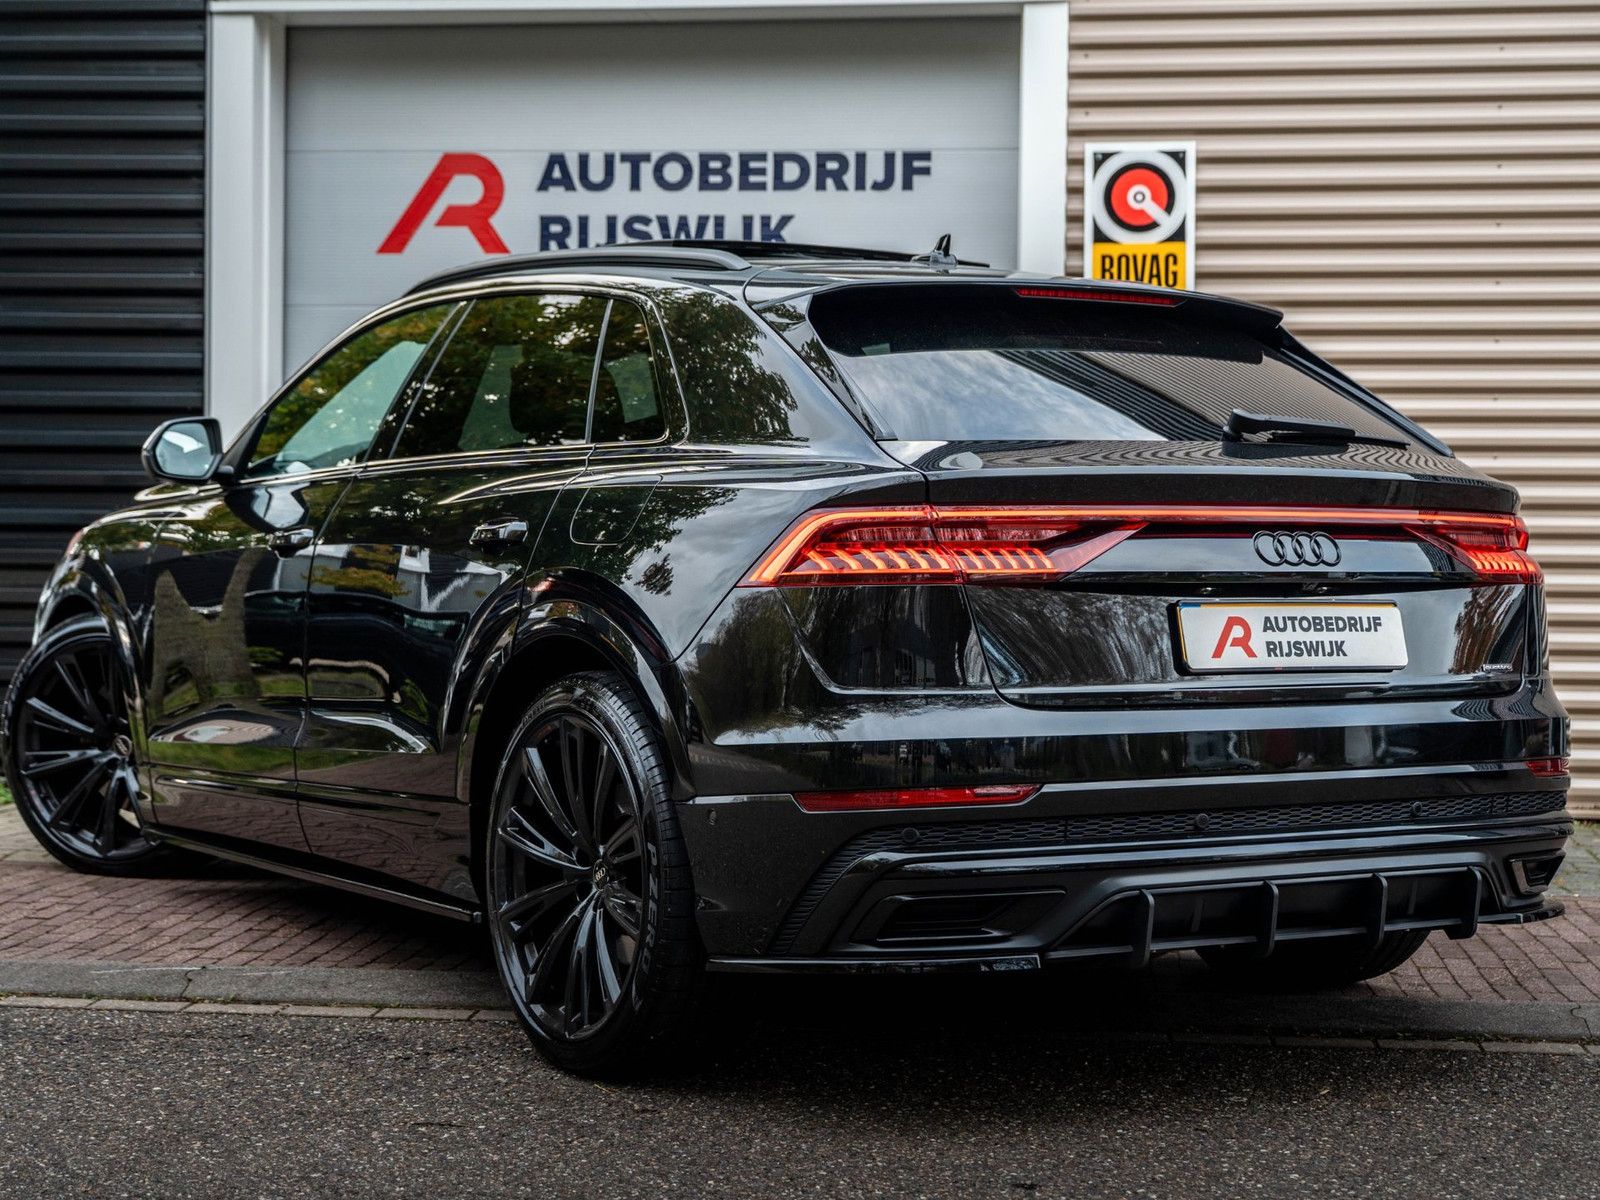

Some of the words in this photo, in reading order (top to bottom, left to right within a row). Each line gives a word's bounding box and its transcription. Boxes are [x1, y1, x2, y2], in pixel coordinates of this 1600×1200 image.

[536, 151, 933, 192] AUTOBEDRIJF
[1100, 253, 1178, 288] BOVAG
[1262, 615, 1382, 633] AUTOBEDRIJF
[1265, 640, 1348, 658] RIJSWIJK
